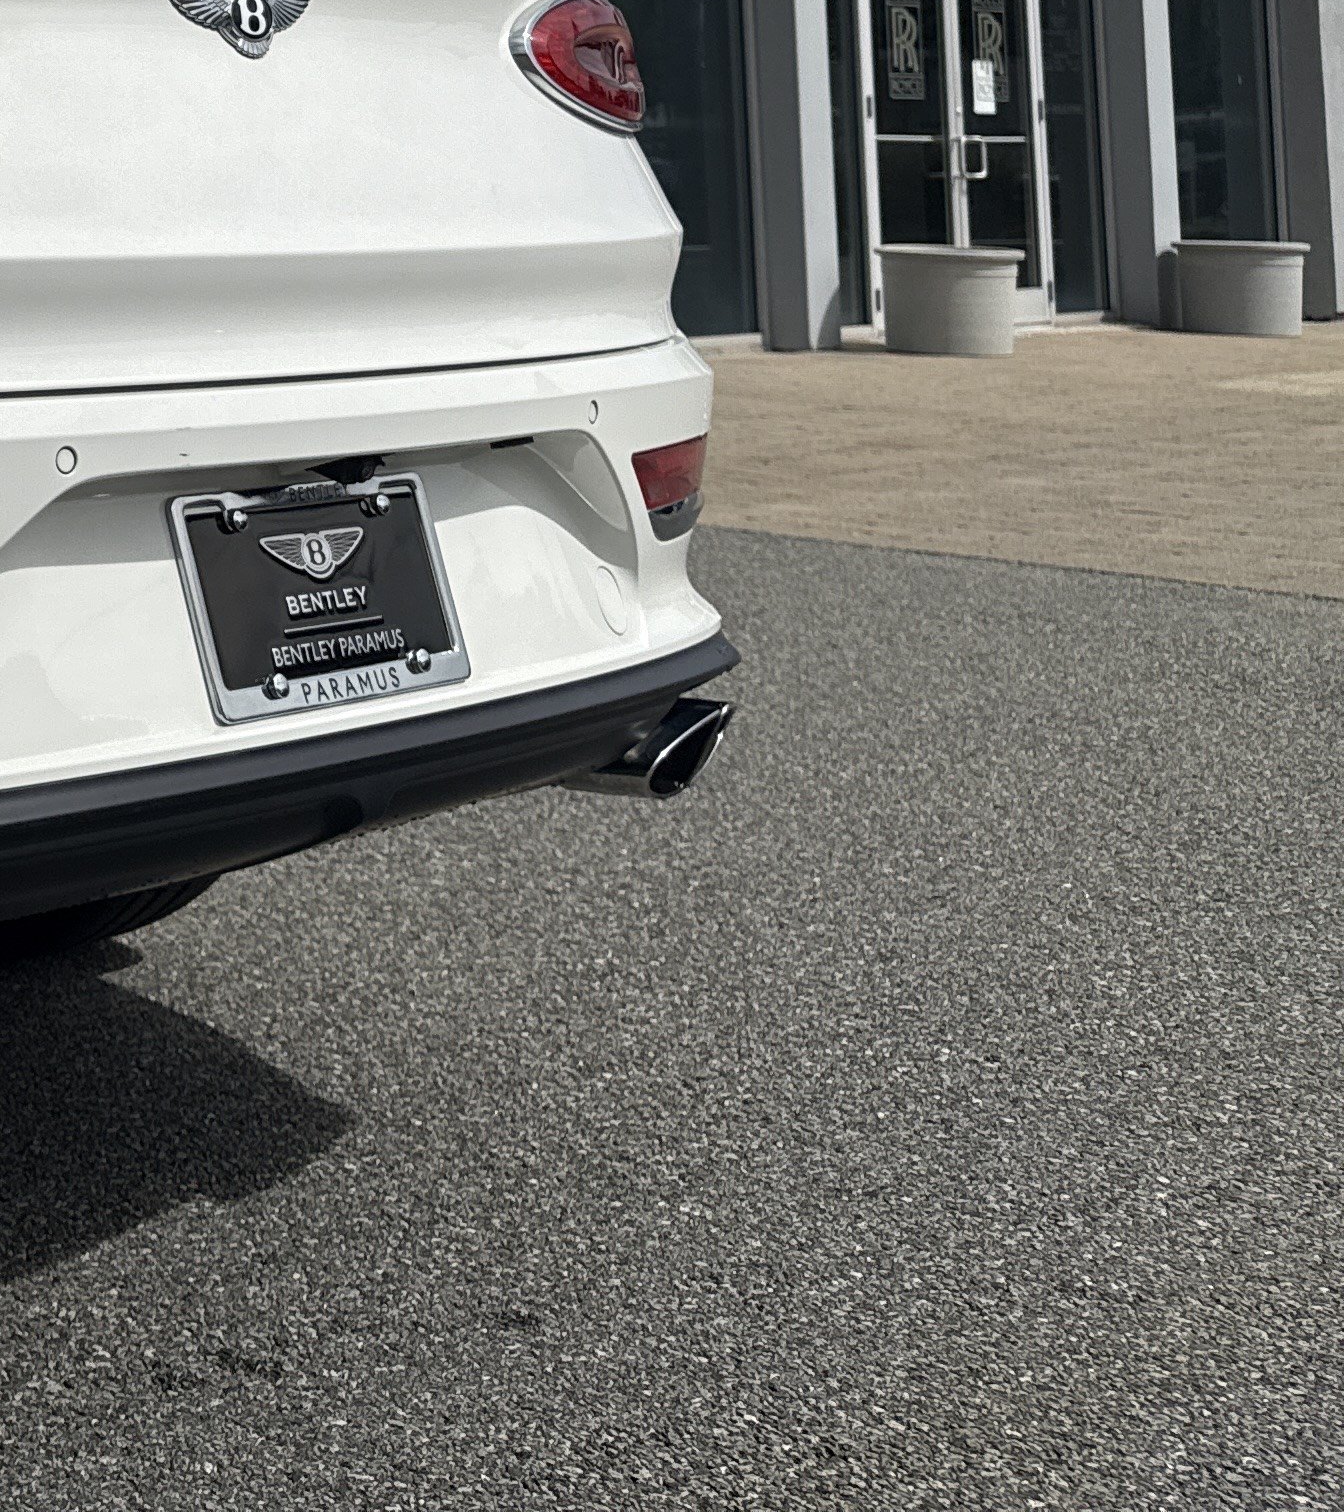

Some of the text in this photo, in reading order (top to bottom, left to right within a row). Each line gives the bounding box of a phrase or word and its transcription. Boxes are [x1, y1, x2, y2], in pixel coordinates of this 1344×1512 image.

[306, 539, 326, 566] B
[285, 585, 366, 616] BENTLEY
[271, 628, 405, 668] BENTLEY PARAMUS
[300, 666, 401, 704] PARAMUS
